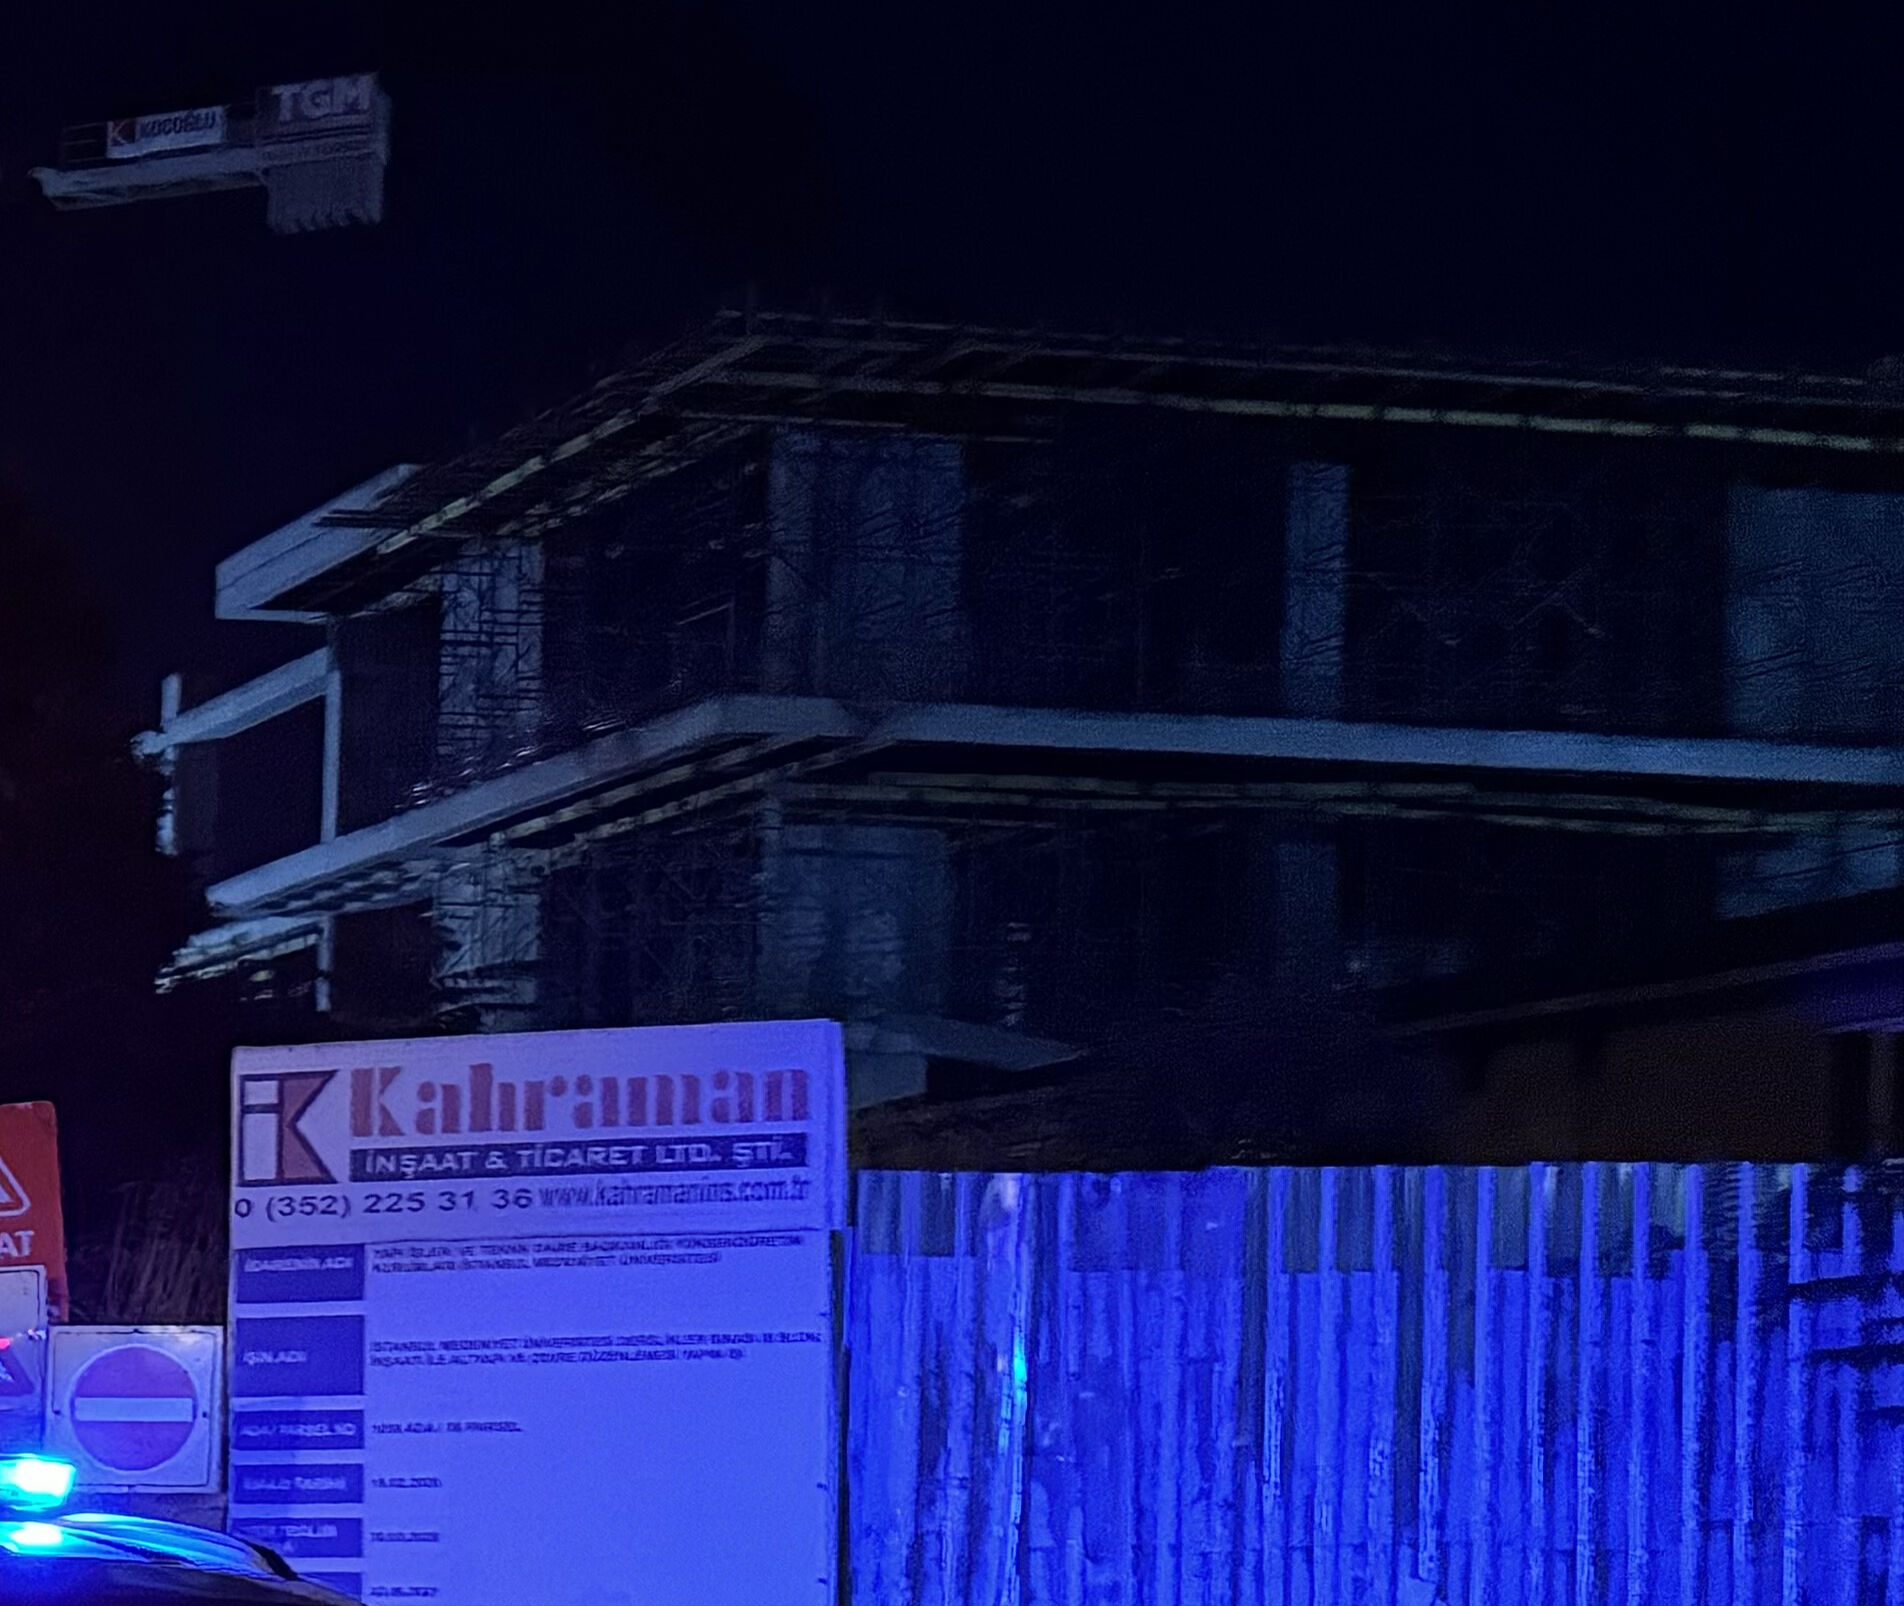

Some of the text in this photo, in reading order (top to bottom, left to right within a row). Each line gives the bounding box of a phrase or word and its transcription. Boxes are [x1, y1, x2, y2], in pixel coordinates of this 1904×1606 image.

[271, 73, 378, 121] TGM
[349, 1063, 809, 1137] Kahraman
[365, 1151, 479, 1179] İNŞAAT
[484, 1151, 507, 1169] &
[516, 1143, 649, 1169] TİCARET
[655, 1144, 722, 1164] LTD.
[234, 1198, 252, 1218] 0
[266, 1195, 352, 1223] (352)
[363, 1192, 427, 1214] 225
[438, 1190, 476, 1211] 31
[492, 1188, 533, 1209] 36
